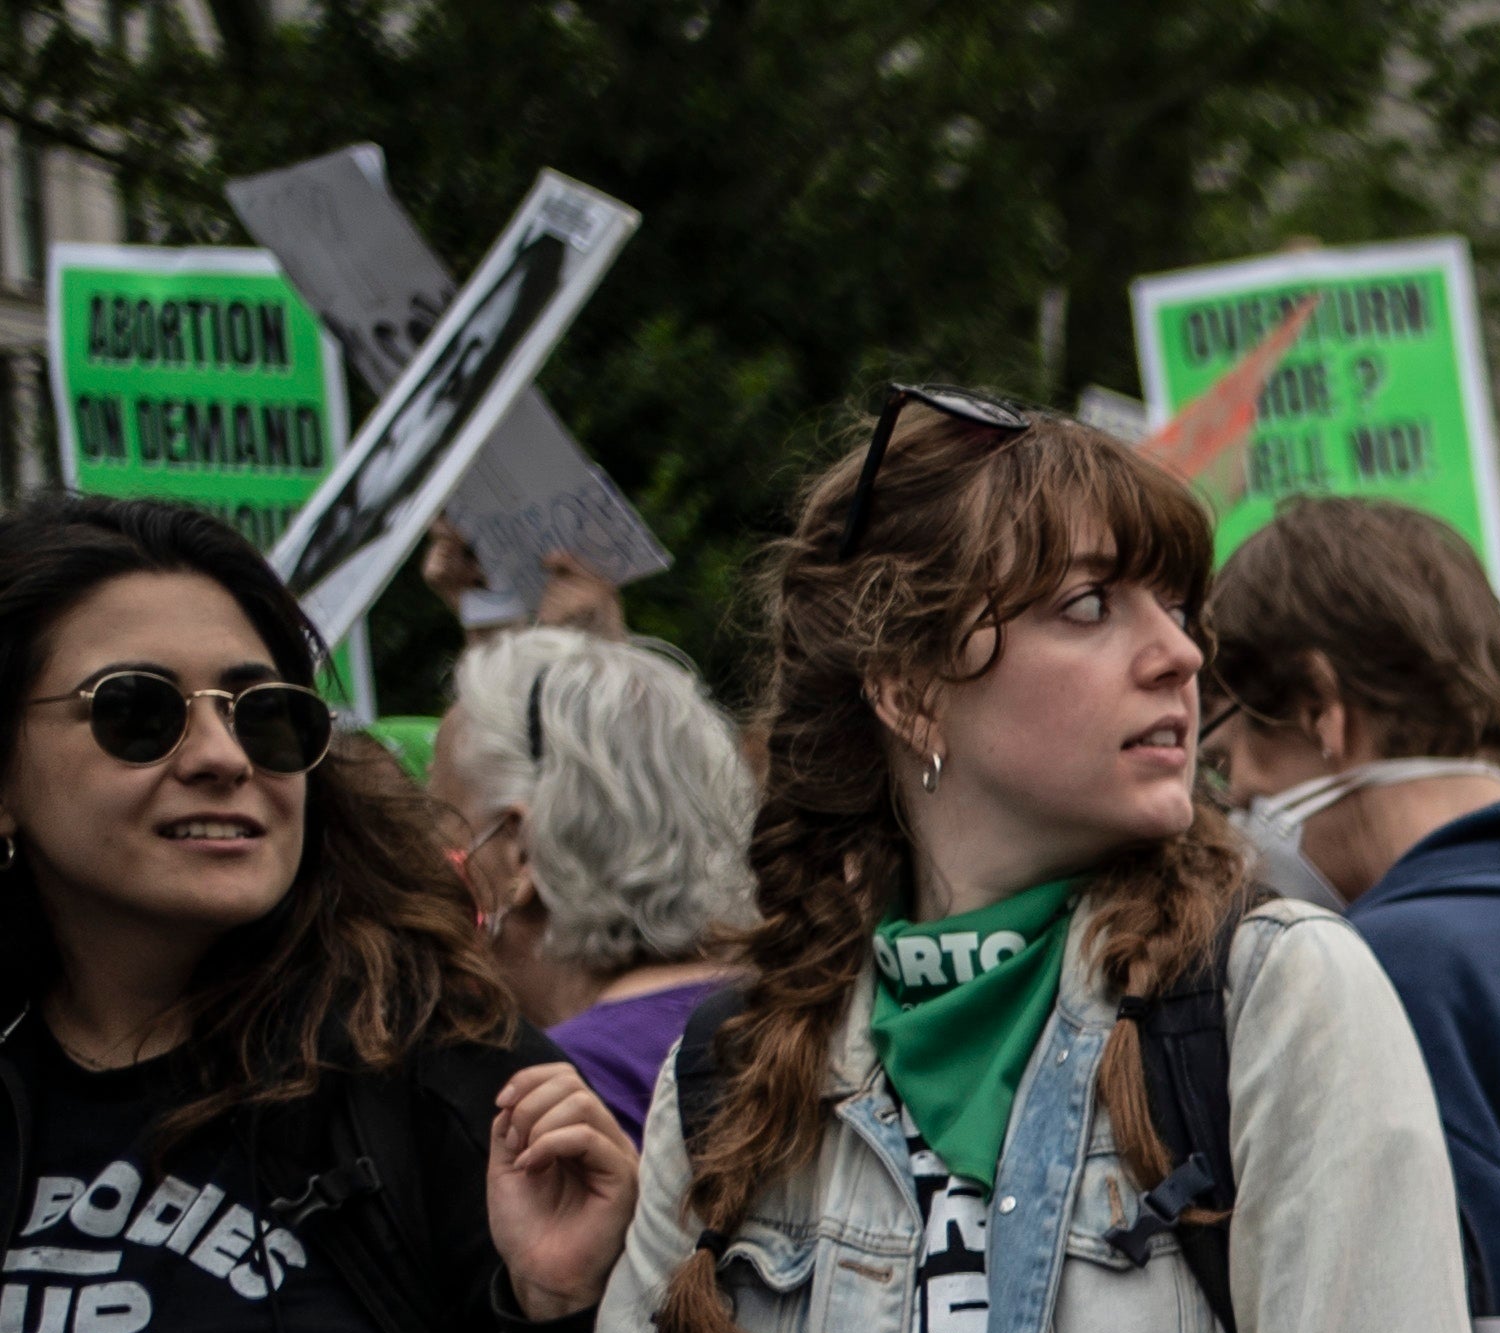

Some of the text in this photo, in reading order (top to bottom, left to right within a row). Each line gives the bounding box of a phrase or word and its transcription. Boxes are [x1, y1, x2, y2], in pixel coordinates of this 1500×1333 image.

[87, 293, 291, 373] ABORTION
[76, 394, 325, 472] ON DEMAND
